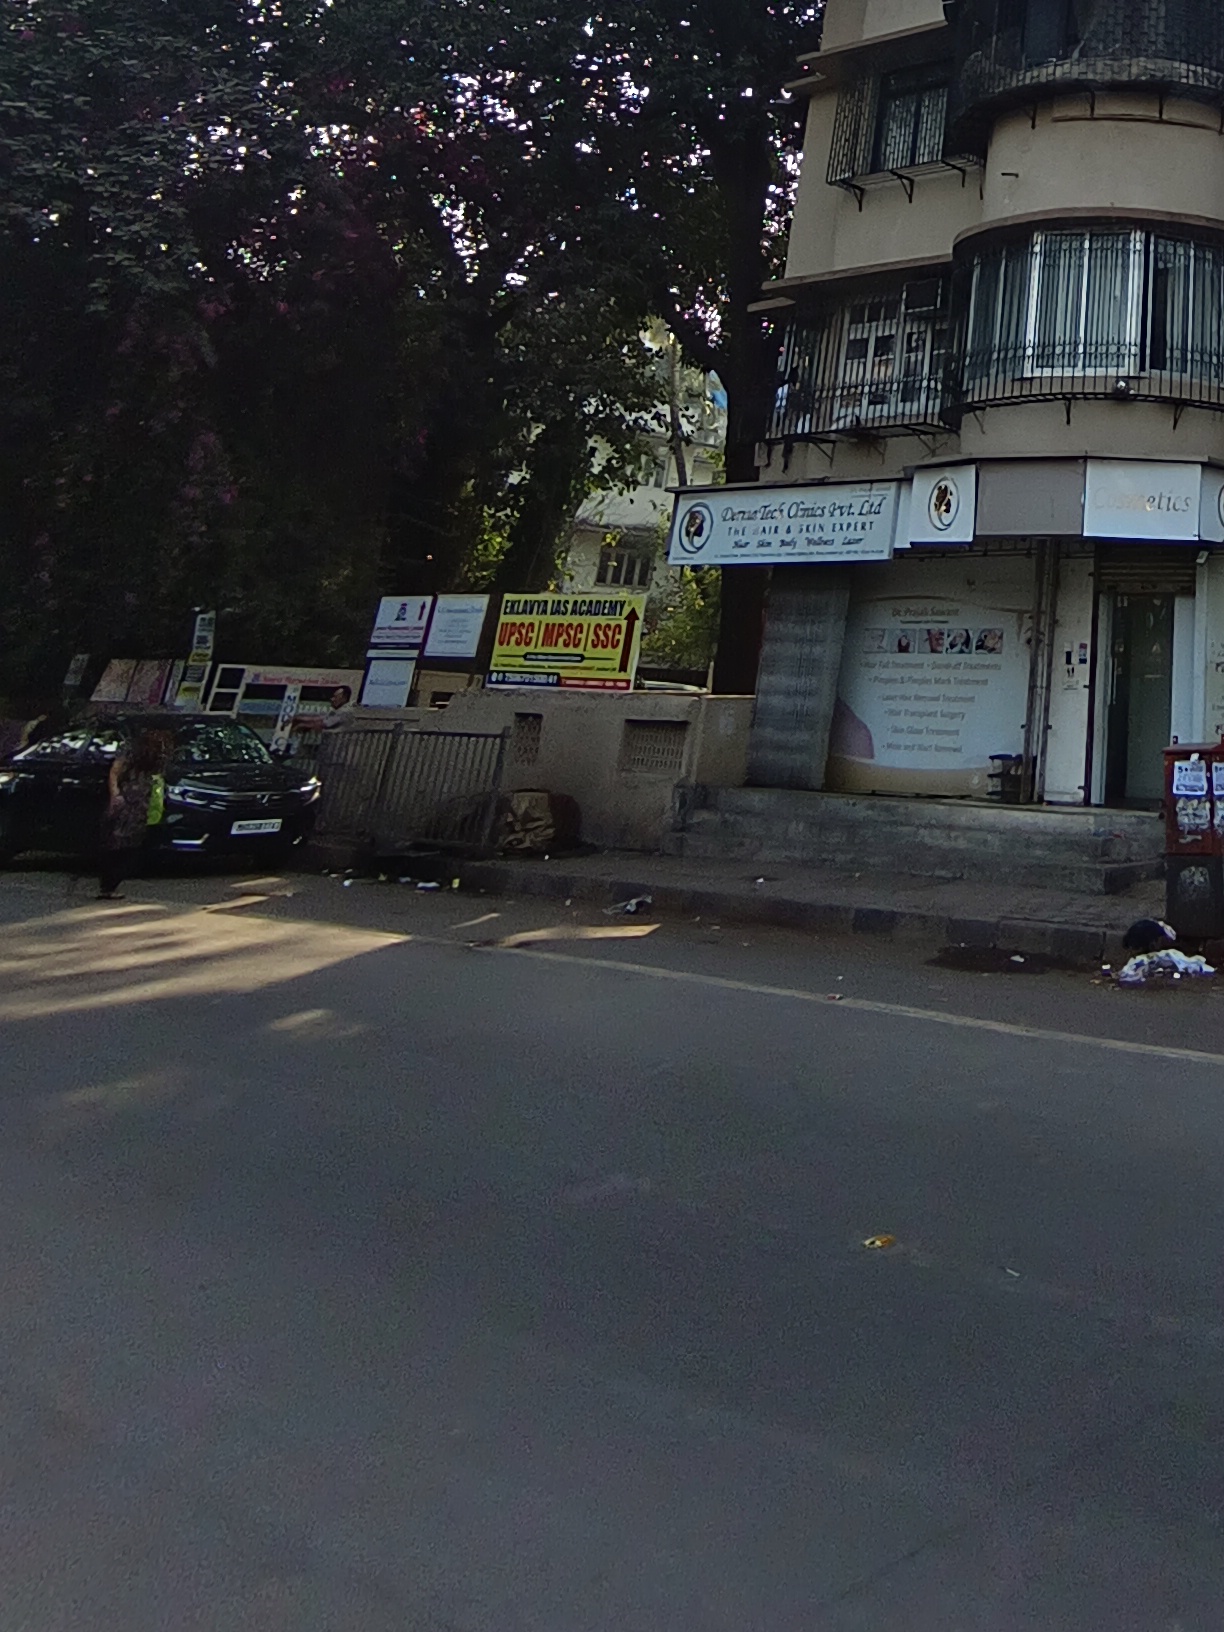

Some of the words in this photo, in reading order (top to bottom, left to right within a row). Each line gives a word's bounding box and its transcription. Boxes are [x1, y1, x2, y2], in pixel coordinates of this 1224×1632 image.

[857, 496, 887, 516] Ltd
[832, 520, 875, 533] EXPERT
[503, 599, 549, 616] EKLAVYA
[550, 599, 569, 616] IAS
[570, 599, 627, 617] ACADEMY
[498, 621, 535, 647] UPSC
[541, 622, 584, 649] MPSC
[591, 623, 623, 650] SSC
